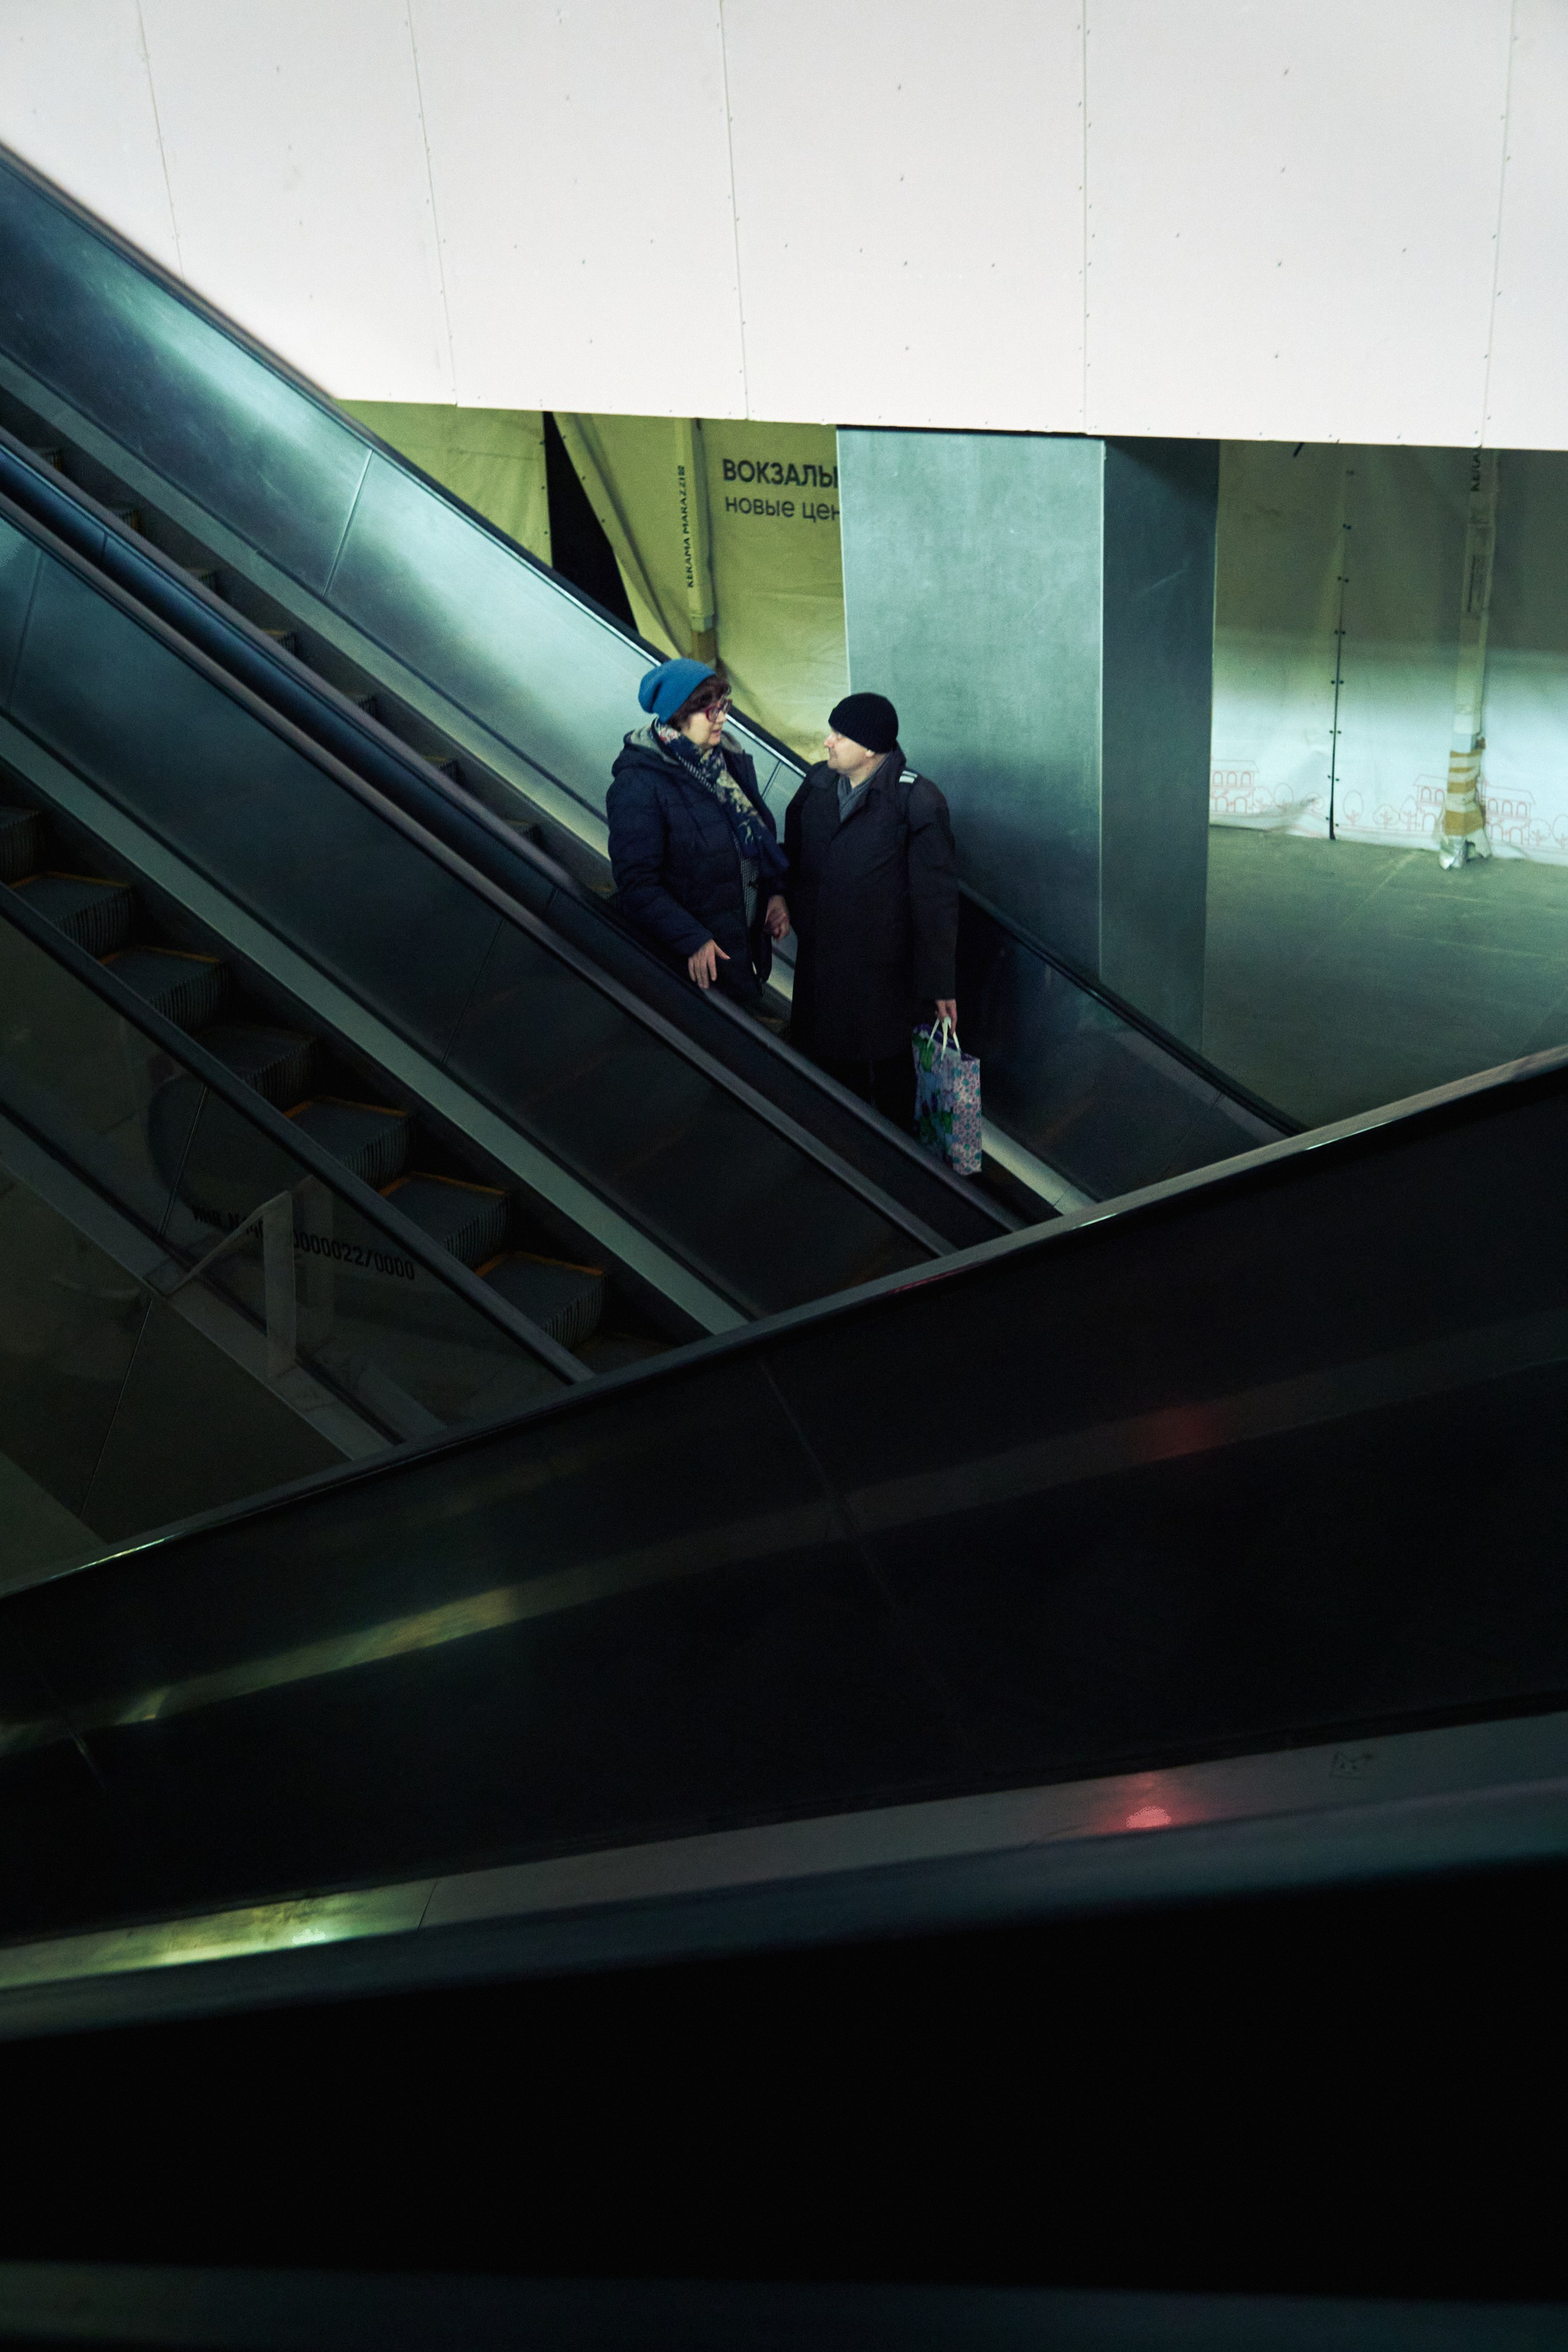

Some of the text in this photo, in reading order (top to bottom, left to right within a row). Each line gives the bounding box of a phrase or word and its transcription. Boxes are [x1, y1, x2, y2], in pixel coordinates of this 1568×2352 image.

[722, 458, 839, 488] ВОКЗАЛЫ
[679, 477, 694, 588] KERAMA MARAZZI
